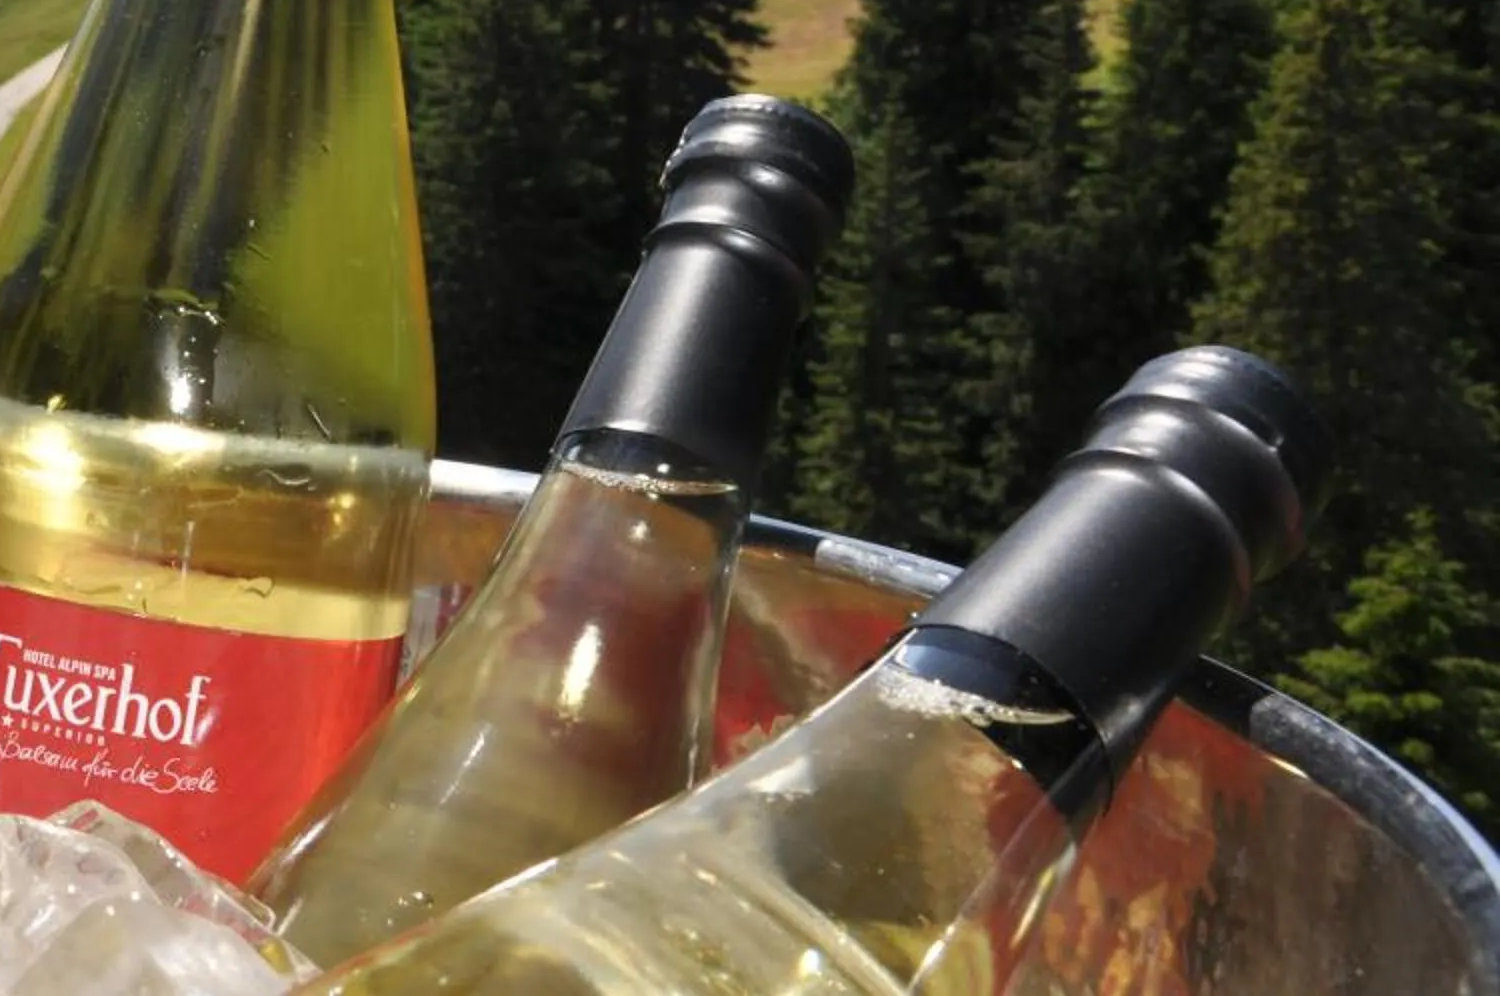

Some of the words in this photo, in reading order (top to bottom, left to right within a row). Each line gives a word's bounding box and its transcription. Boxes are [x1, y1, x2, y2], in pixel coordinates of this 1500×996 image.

[23, 649, 56, 668] HOTEL
[58, 656, 91, 675] ALPIN
[93, 664, 116, 681] SPA
[121, 755, 158, 790] die
